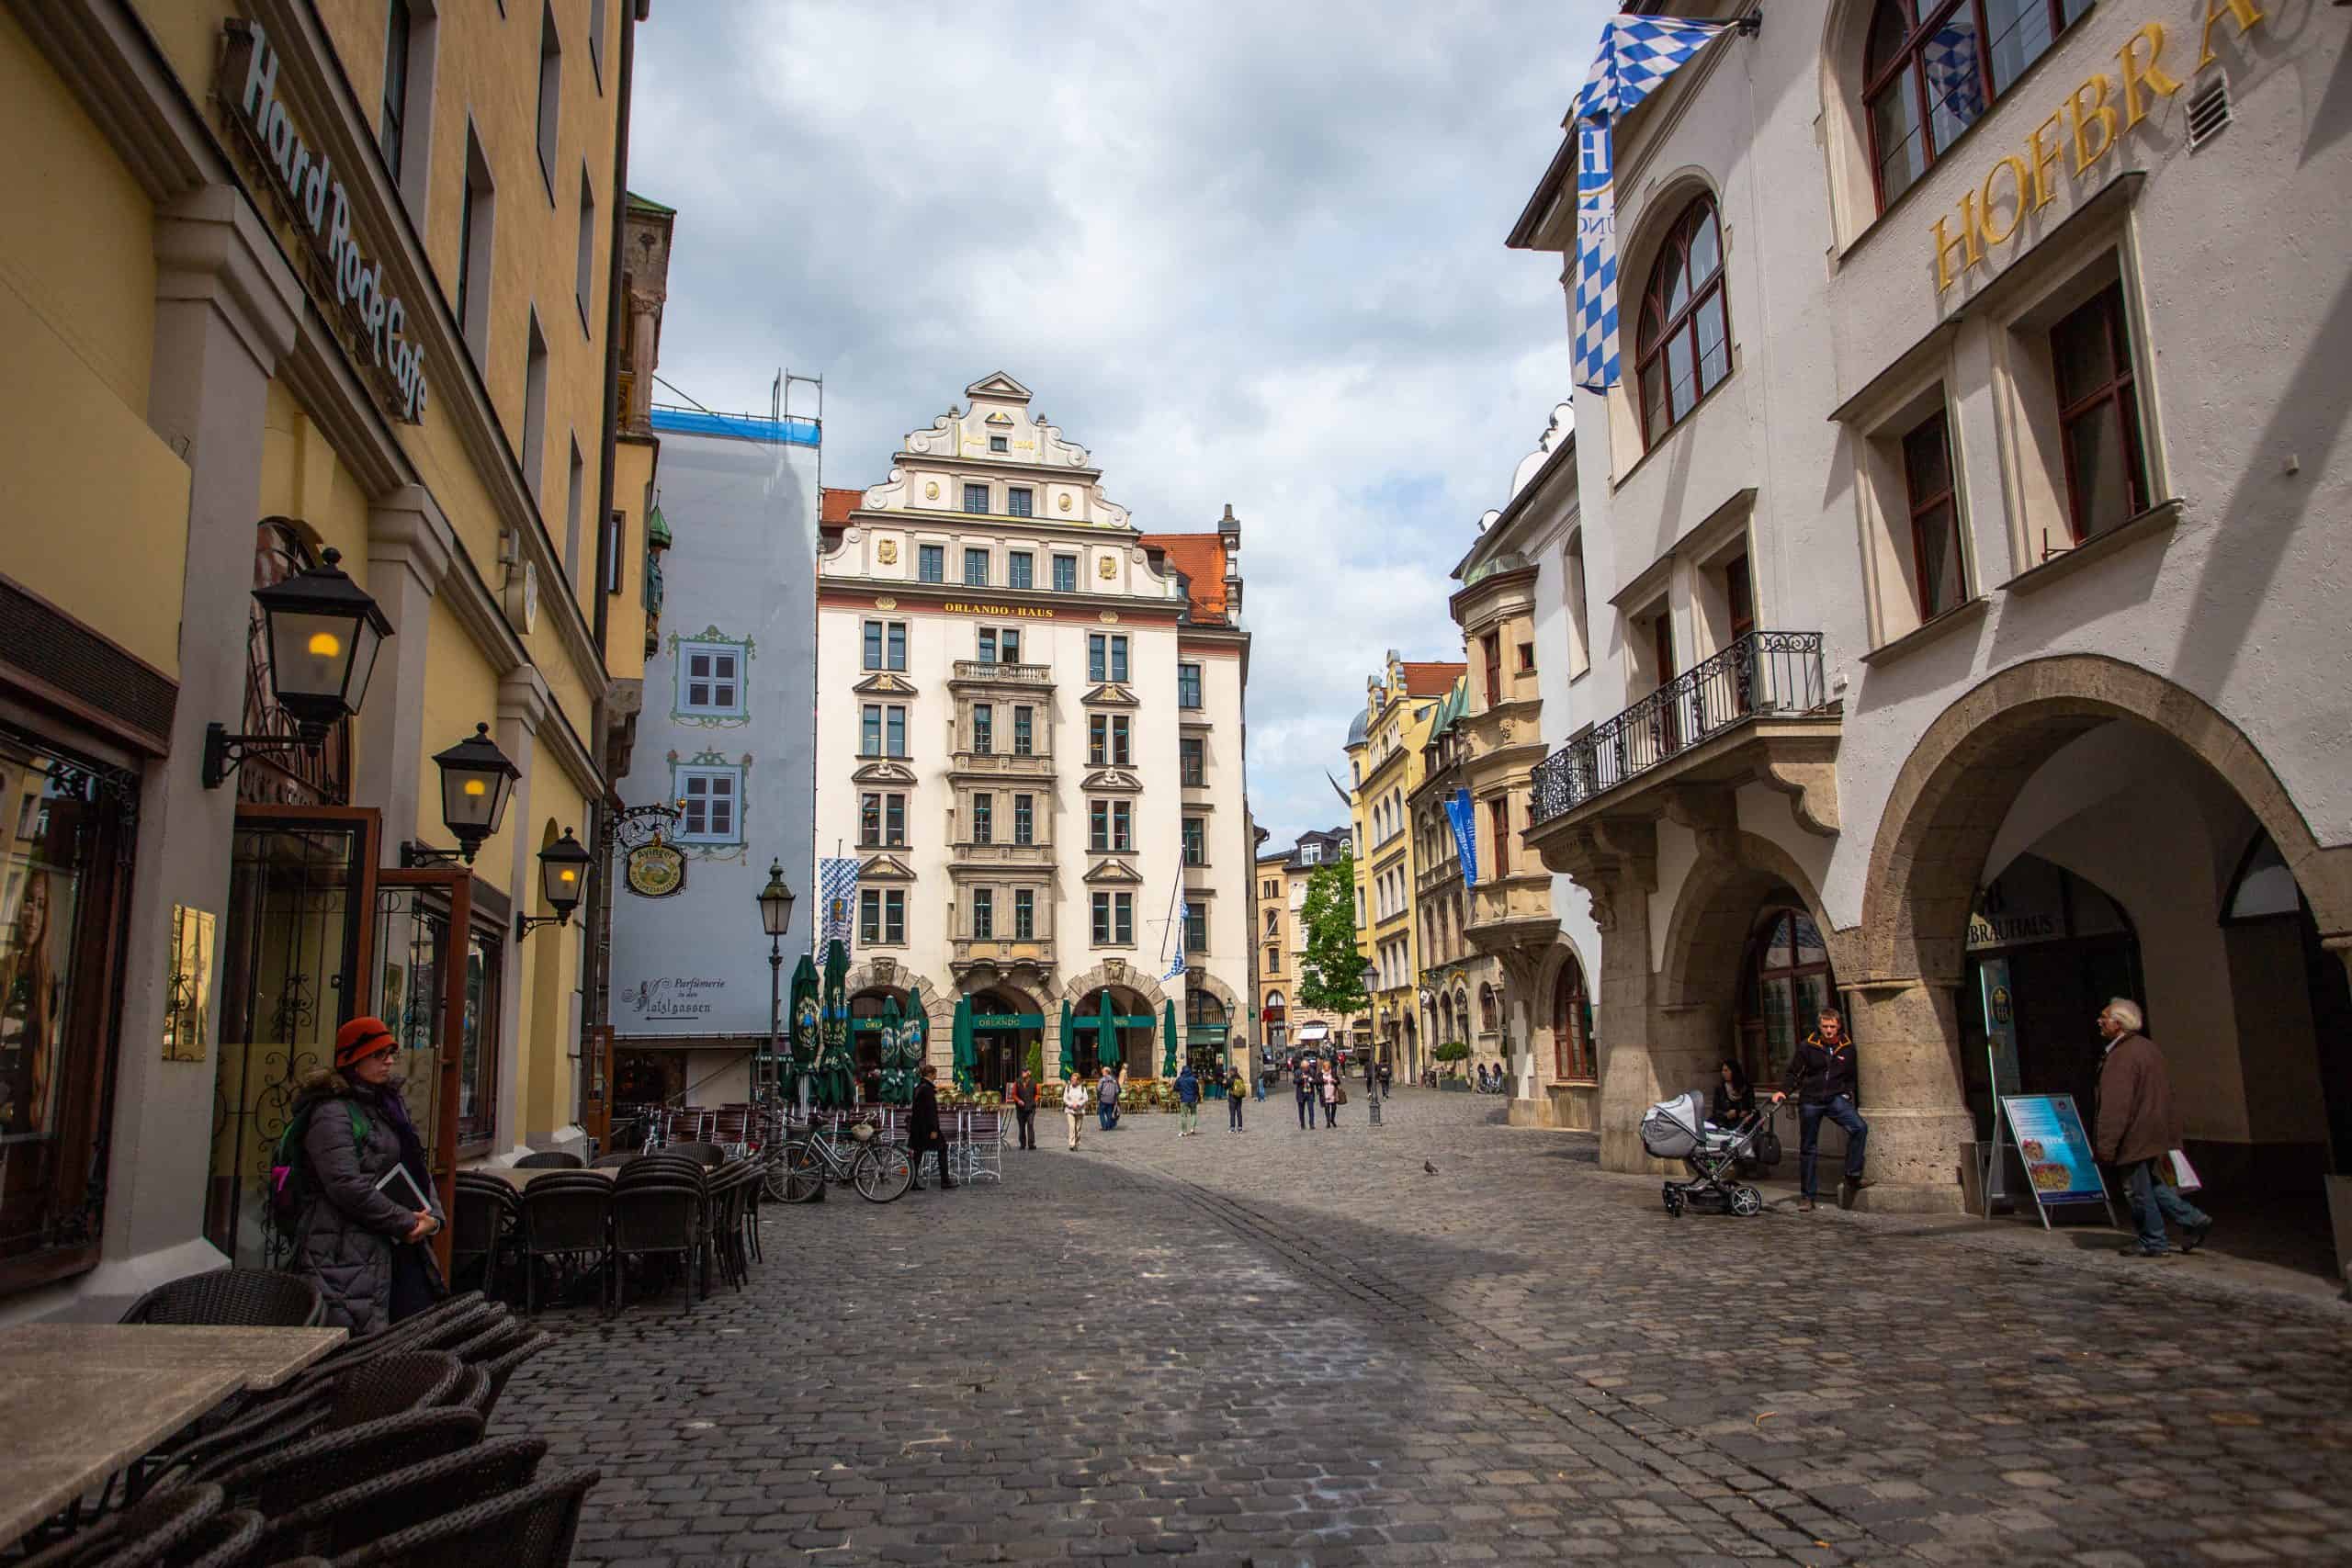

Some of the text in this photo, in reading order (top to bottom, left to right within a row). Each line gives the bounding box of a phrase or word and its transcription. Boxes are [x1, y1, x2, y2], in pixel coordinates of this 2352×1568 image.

[243, 20, 330, 236] Hard
[328, 181, 383, 367] Rock
[944, 603, 1054, 618] ORLANDO HAUS
[638, 847, 677, 860] Ayinger
[674, 977, 726, 991] Parfümerie
[978, 1018, 1020, 1027] ORLANDO
